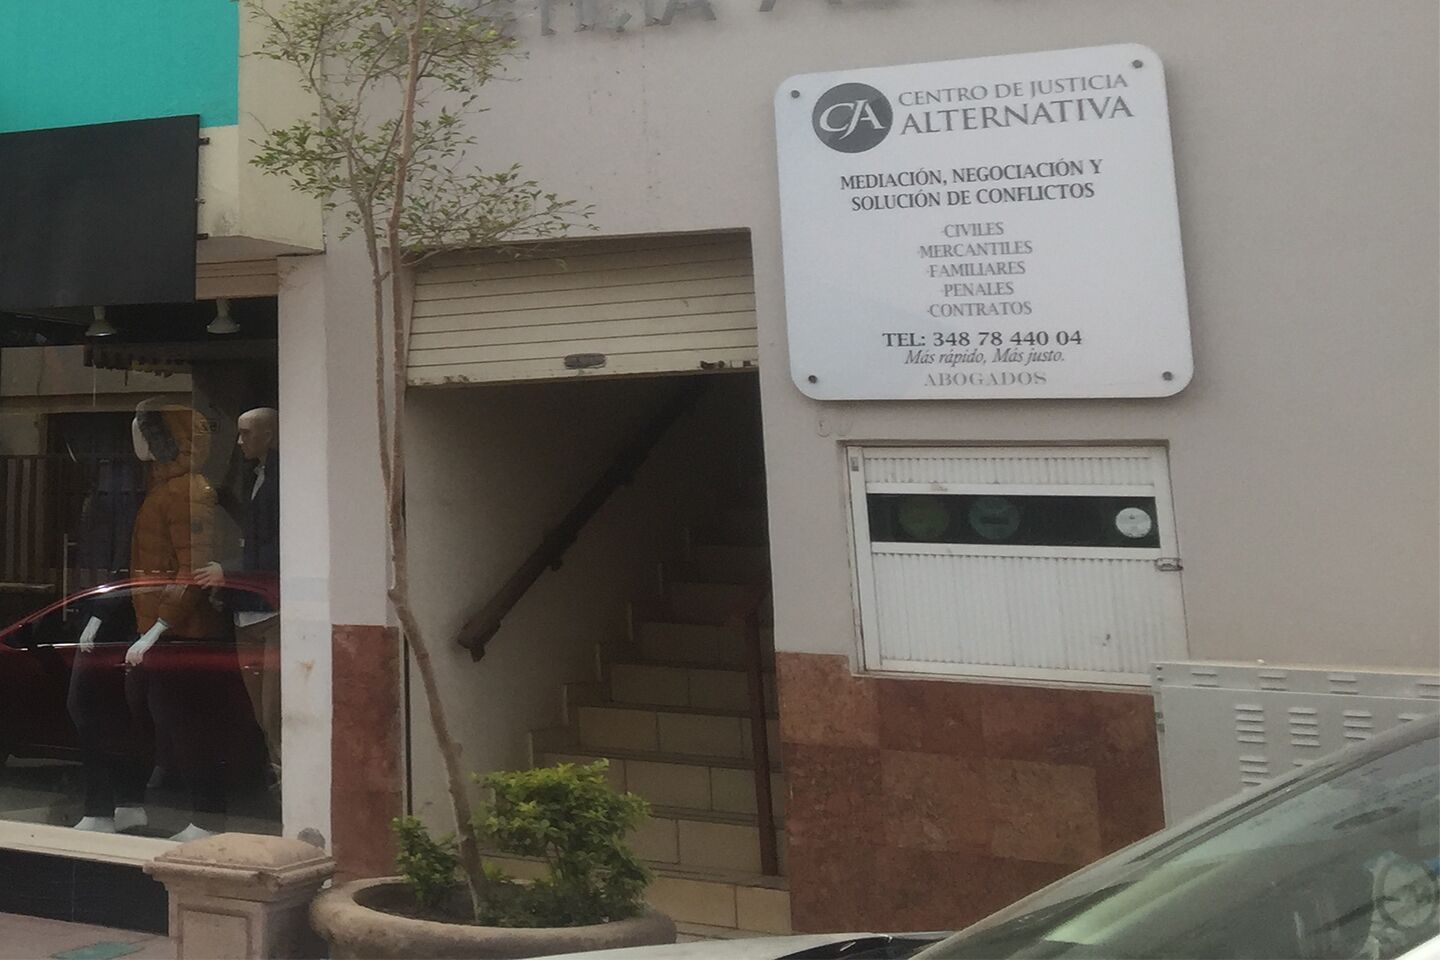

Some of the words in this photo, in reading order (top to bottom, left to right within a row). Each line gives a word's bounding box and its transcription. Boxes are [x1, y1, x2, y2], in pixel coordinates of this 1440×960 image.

[898, 85, 988, 107] CENTRO
[994, 82, 1024, 99] DE
[1029, 73, 1128, 98] JUSTICIA
[900, 96, 1135, 135] ALTERNATIVA
[841, 168, 948, 190] MEDIACIÓN,
[952, 158, 1084, 184] NEGOCIACIÓN
[1089, 159, 1103, 175] Y
[851, 190, 941, 211] SOLUCIÓN
[947, 190, 972, 206] DE
[976, 182, 1095, 205] CONFLICTOS
[944, 281, 1015, 297] PENALES
[882, 332, 926, 347] TEL:
[933, 331, 971, 347] 348
[978, 331, 1003, 346] 78
[1010, 331, 1049, 346] 440
[1056, 330, 1082, 346] 04
[904, 349, 935, 365] Más
[938, 349, 987, 368] rápido,
[992, 348, 1024, 363] Más
[1025, 348, 1065, 366] justo.
[924, 371, 1048, 387] ABOGADOS
